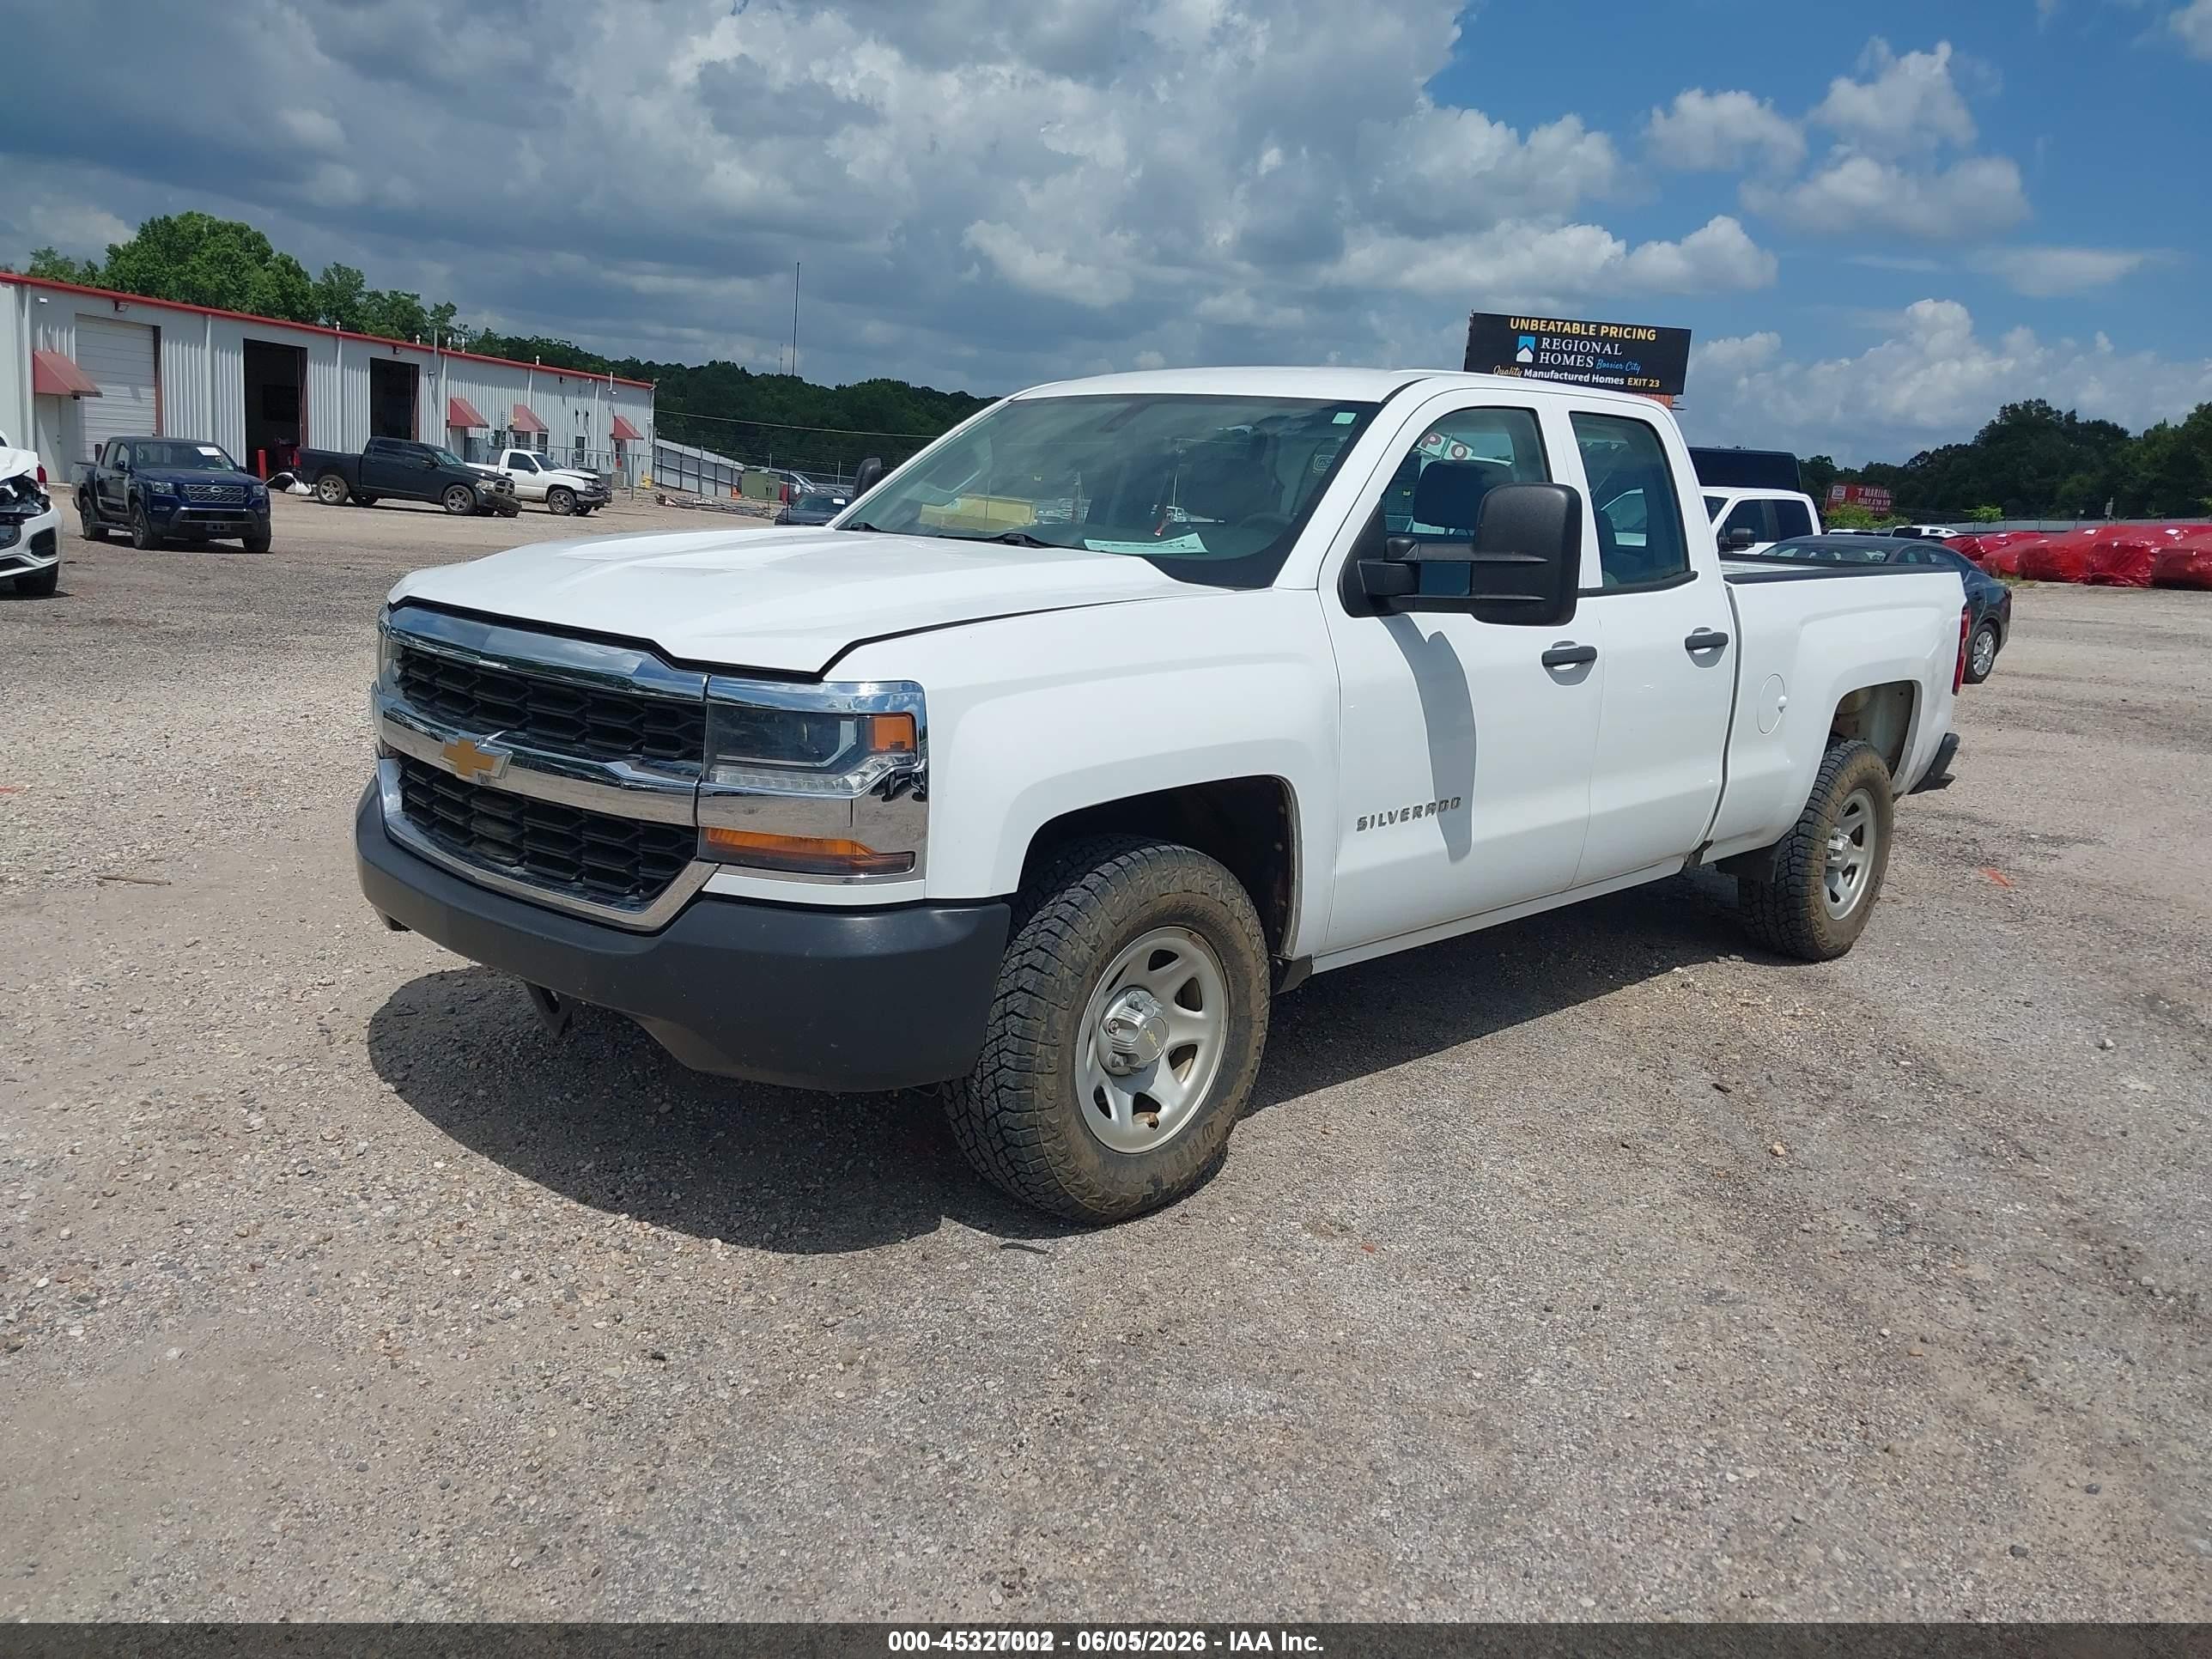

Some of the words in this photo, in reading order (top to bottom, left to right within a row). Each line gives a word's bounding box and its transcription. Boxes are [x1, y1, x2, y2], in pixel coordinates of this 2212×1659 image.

[1510, 317, 1596, 336] UNBEATABLE
[1600, 325, 1656, 341] PRICING
[1540, 337, 1623, 356] REGIONAL
[1538, 351, 1595, 368] HOMES
[1595, 358, 1624, 370] Bossier
[1625, 361, 1642, 375] City
[1492, 364, 1523, 378] Quality
[1523, 368, 1590, 383] Manufactured
[1591, 374, 1625, 386] Homes
[1627, 377, 1648, 387] EXIT
[1648, 379, 1660, 388] 23
[1356, 796, 1462, 832] SILVERADO
